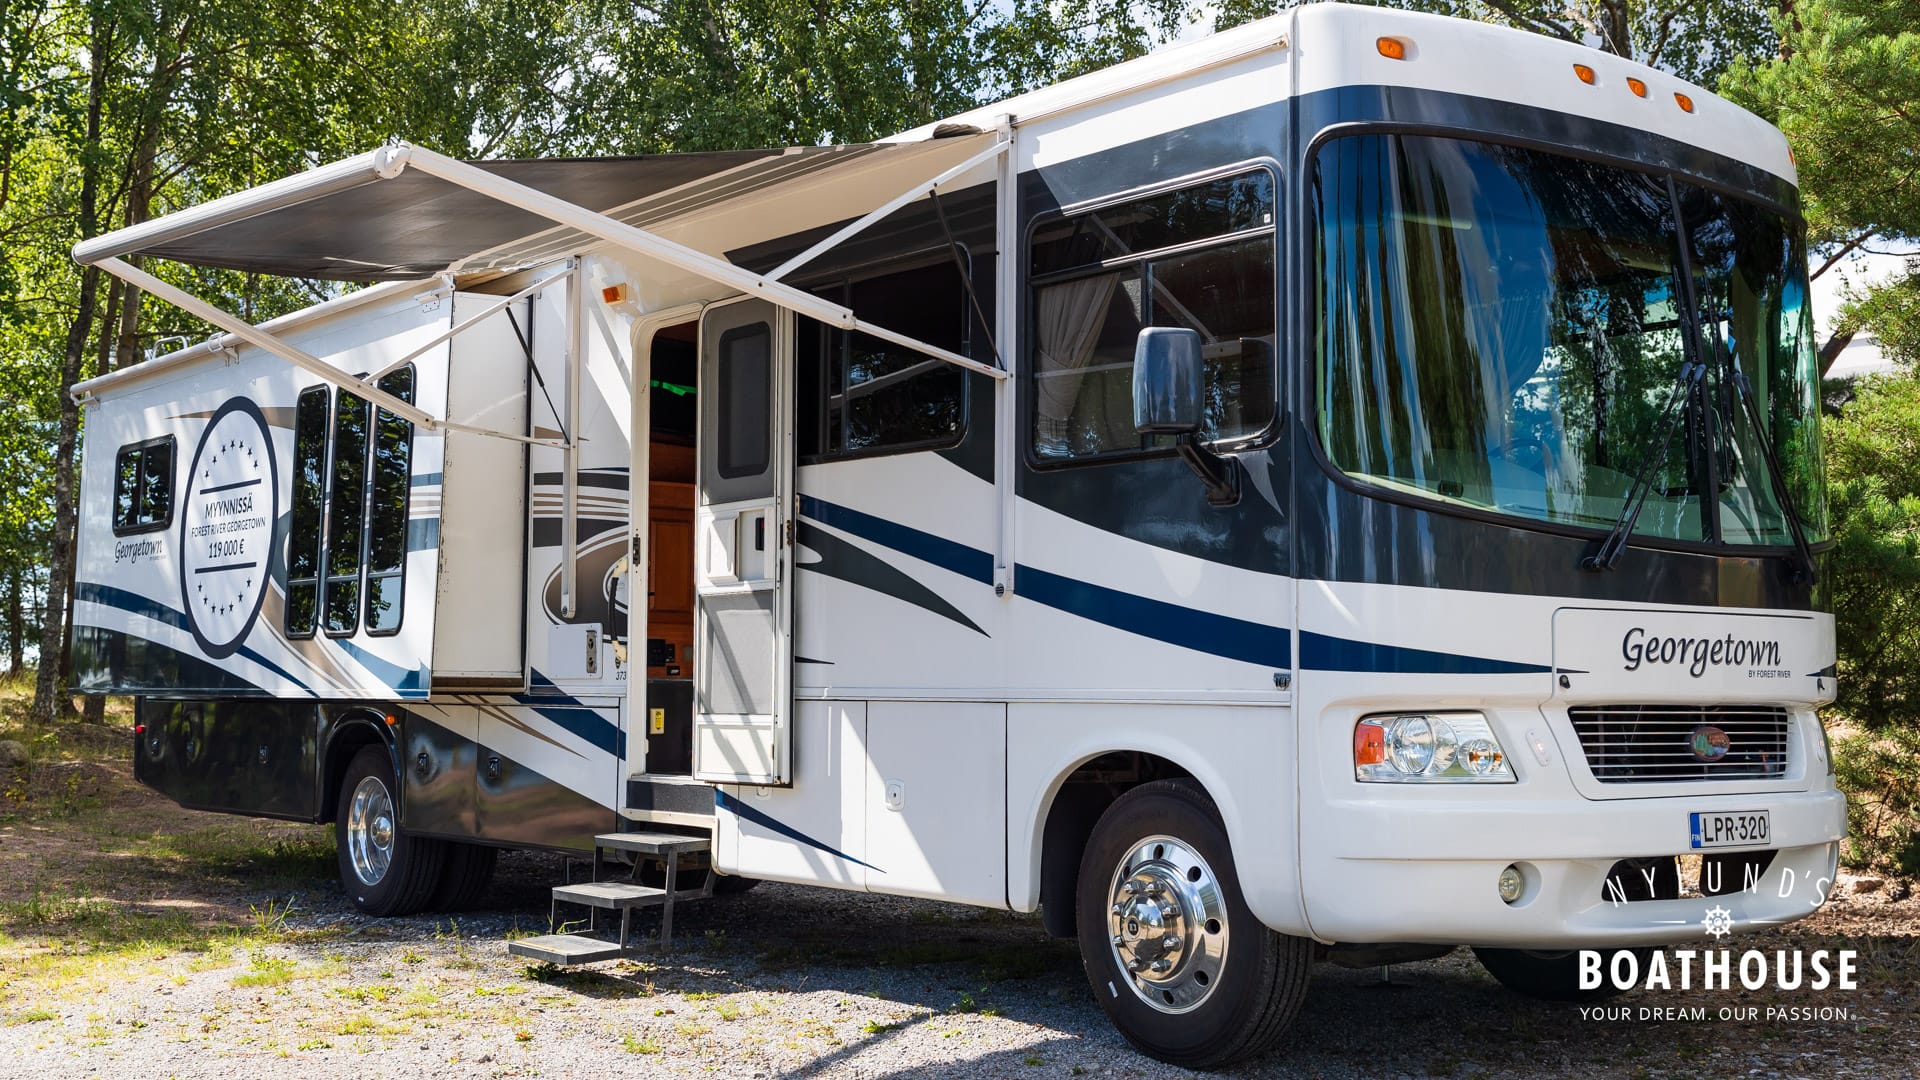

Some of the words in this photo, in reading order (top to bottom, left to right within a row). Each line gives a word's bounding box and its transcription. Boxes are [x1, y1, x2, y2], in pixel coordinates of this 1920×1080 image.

[205, 492, 253, 519] MYYNNISSÄ
[191, 524, 211, 538] FOREST
[211, 522, 227, 535] RIVER
[227, 517, 266, 533] GEORGETOWN
[114, 538, 162, 564] Georgetown
[208, 541, 223, 559] 119
[223, 539, 238, 557] 000
[239, 538, 245, 555] €
[1622, 627, 1781, 678] Georgetown
[615, 671, 627, 681] 373
[1748, 670, 1756, 678] BY
[1757, 670, 1776, 678] FOREST
[1777, 670, 1791, 679] RIVER
